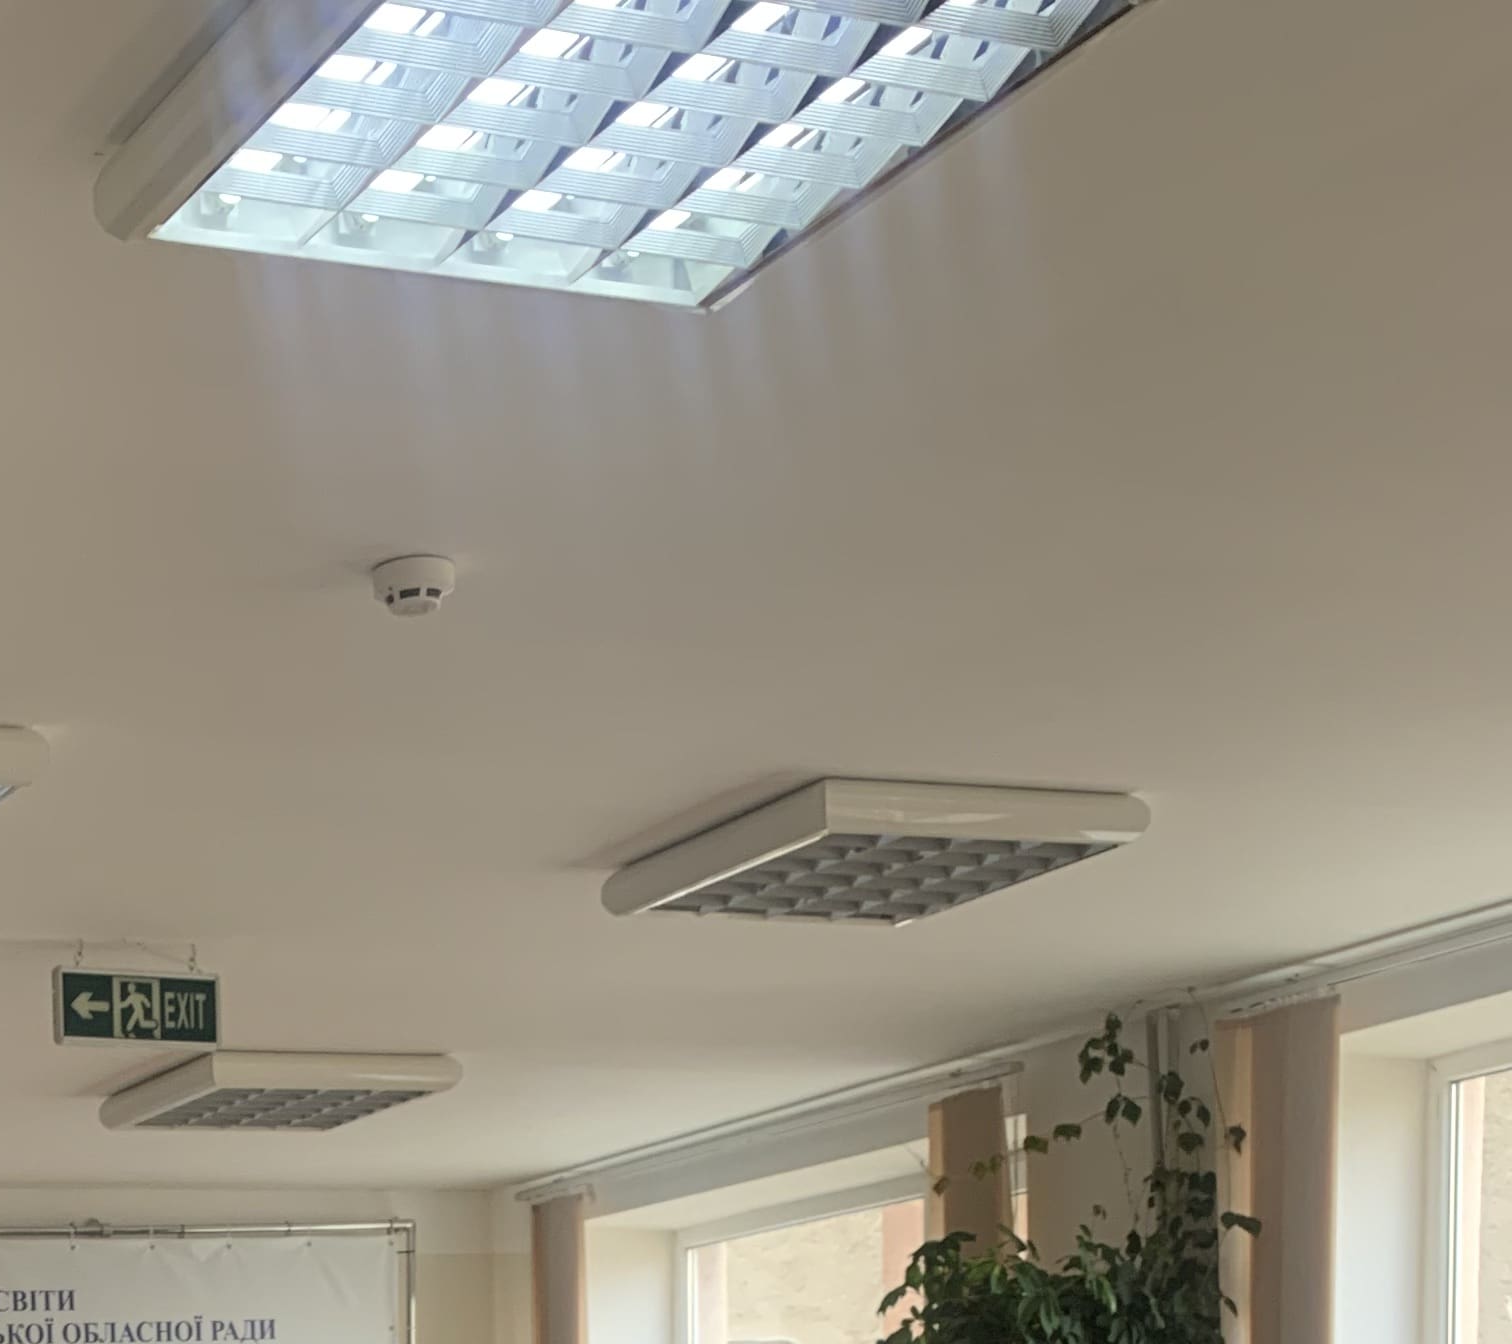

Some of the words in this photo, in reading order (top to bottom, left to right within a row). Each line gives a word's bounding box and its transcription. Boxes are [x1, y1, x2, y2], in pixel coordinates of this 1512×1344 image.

[164, 992, 206, 1030] EXIT
[62, 1316, 202, 1344] ОБЛАСНОЇ
[212, 1319, 275, 1342] РАДИ
